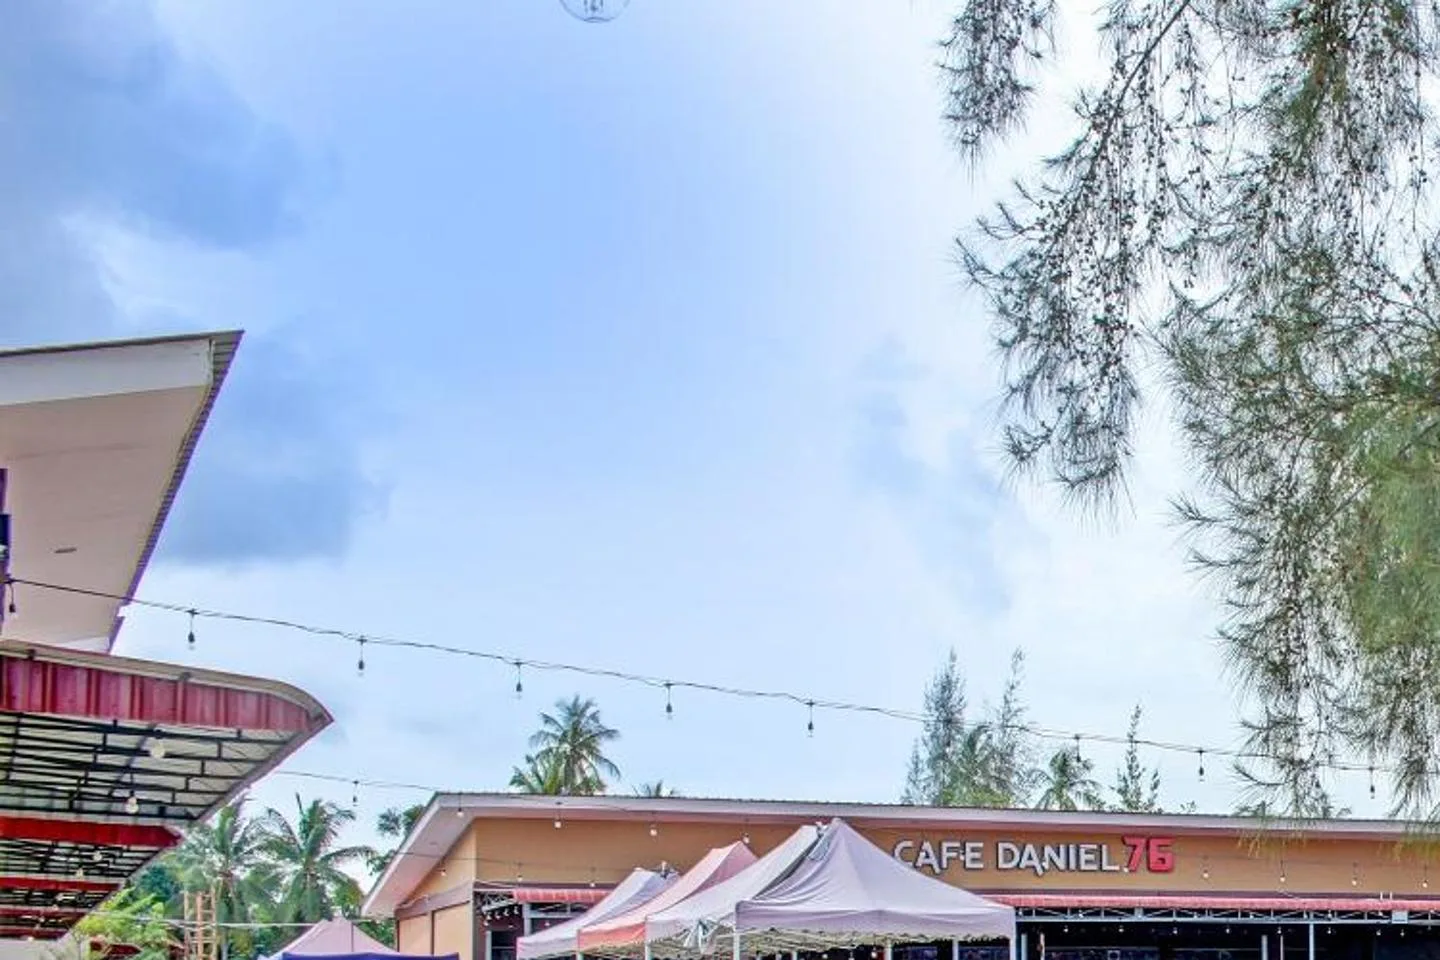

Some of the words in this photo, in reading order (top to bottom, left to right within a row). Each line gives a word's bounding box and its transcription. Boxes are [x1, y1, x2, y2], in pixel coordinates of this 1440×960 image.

[893, 840, 984, 873] CAFE
[998, 842, 1120, 875] DANIEL
[1122, 835, 1175, 872] 76
